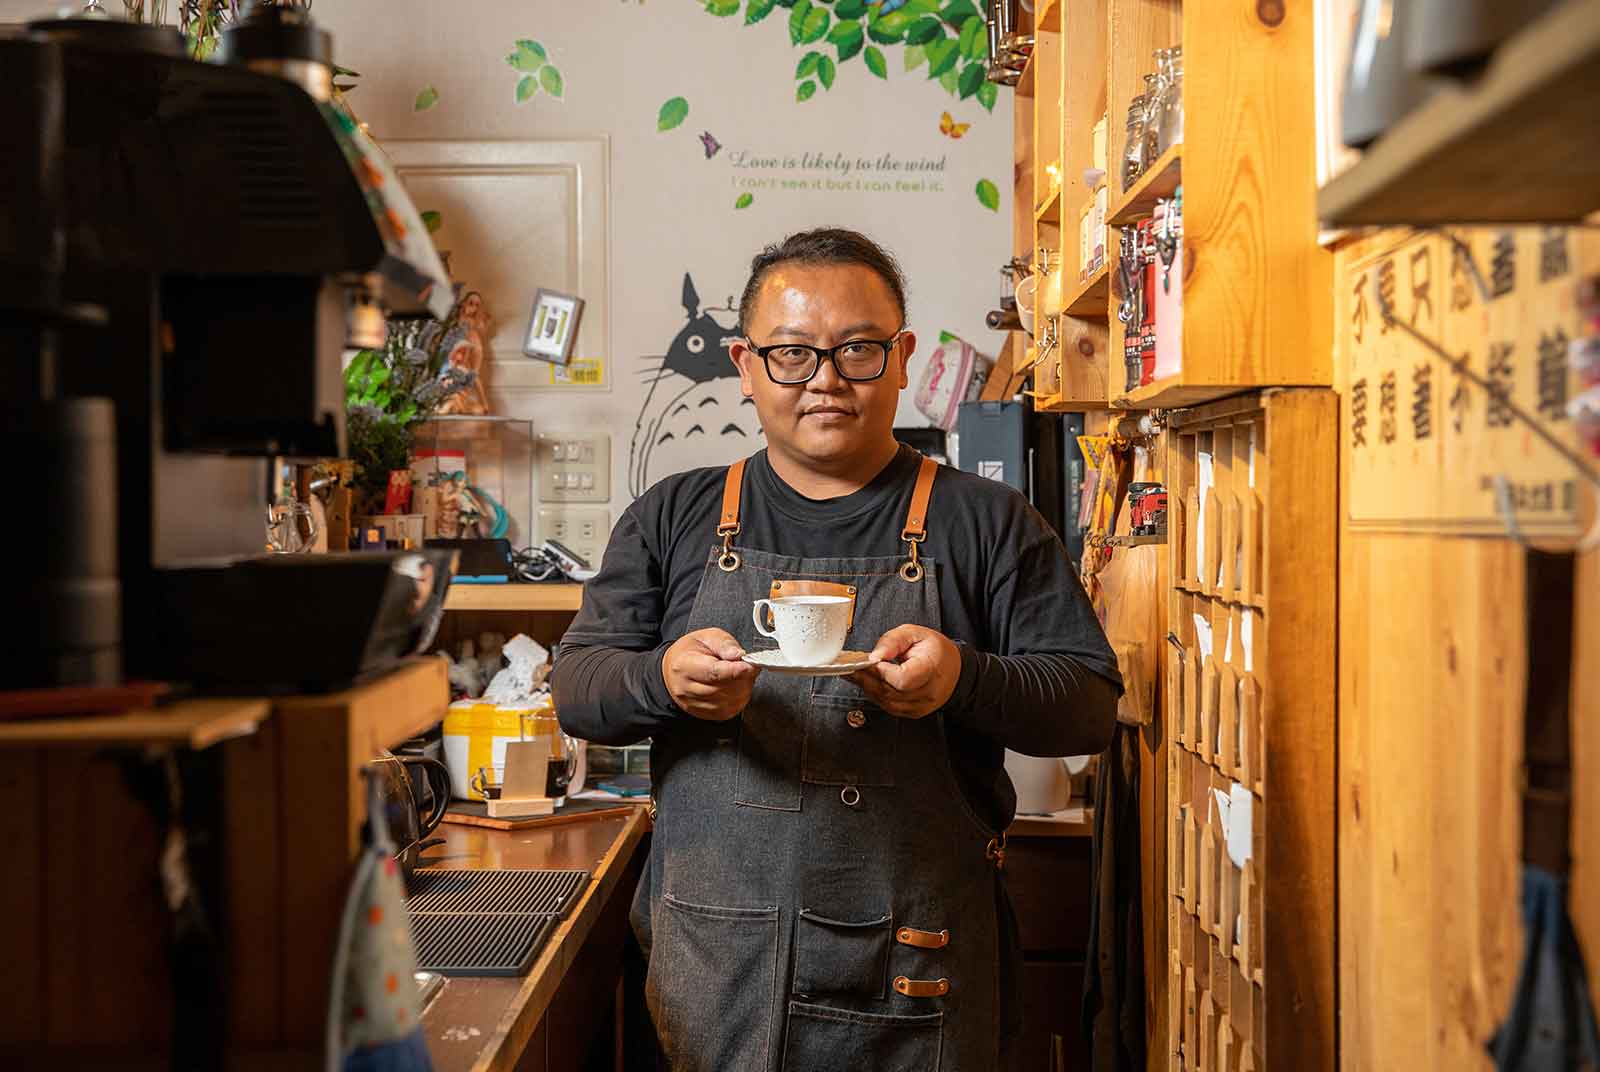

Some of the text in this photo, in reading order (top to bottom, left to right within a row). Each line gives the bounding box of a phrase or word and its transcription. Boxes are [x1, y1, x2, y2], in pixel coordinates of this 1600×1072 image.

[729, 151, 946, 175] Love is likely to the wind
[826, 177, 851, 191] but
[864, 179, 892, 192] can
[895, 178, 926, 193] feel
